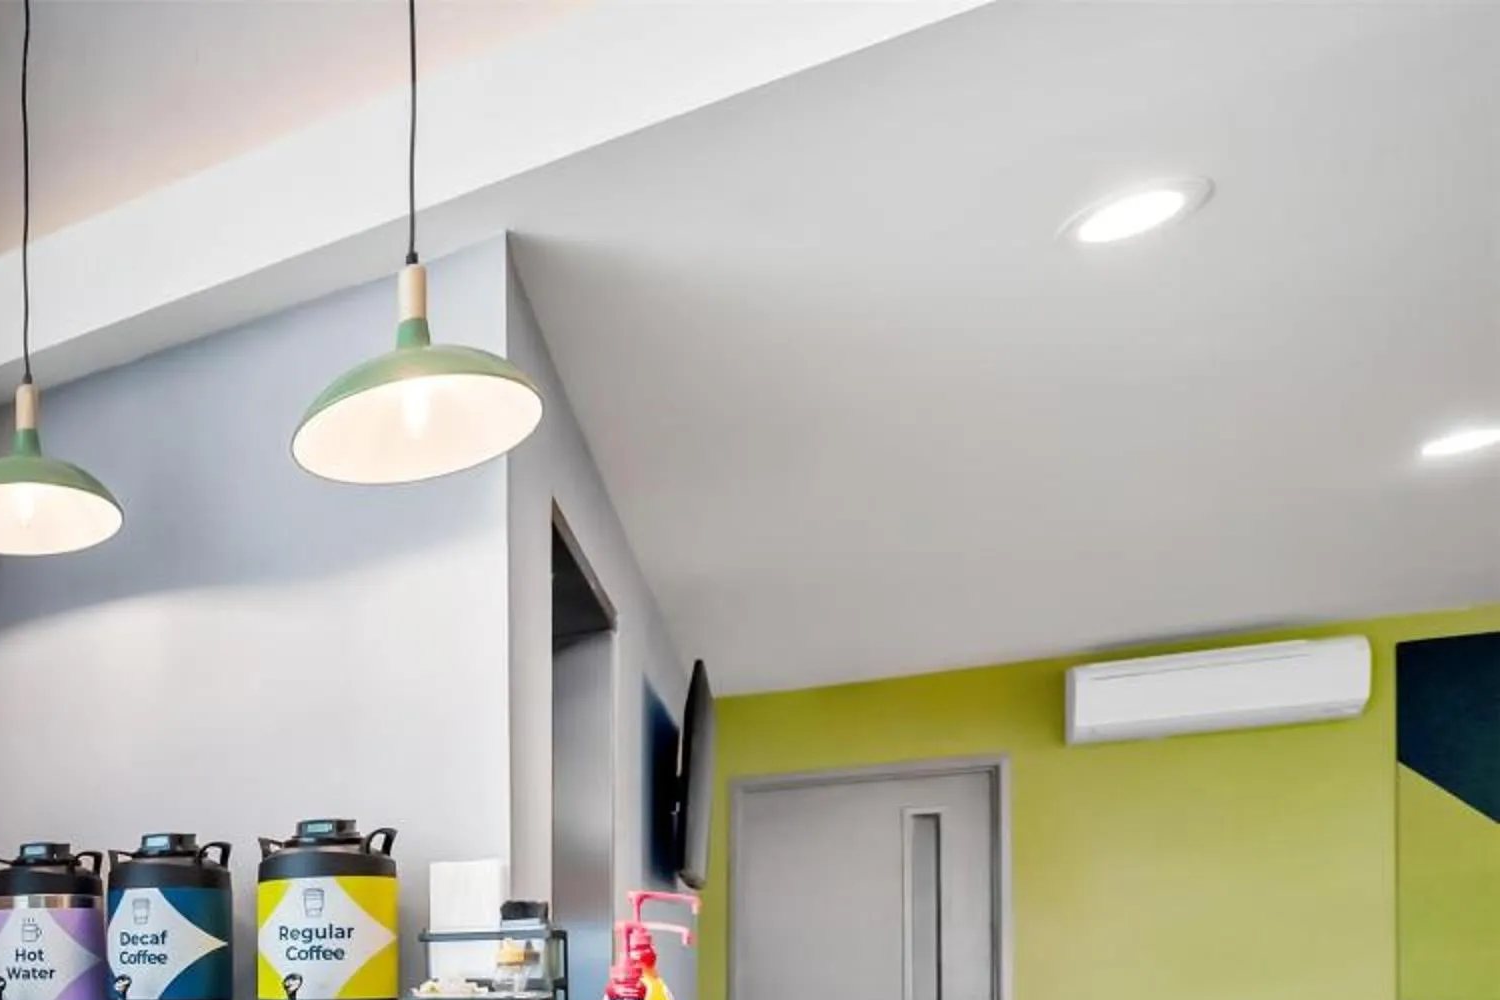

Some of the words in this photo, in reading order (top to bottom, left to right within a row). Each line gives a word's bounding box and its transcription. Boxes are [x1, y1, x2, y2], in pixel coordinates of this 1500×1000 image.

[120, 930, 167, 946] Decaf
[278, 923, 355, 943] Regular
[15, 949, 45, 963] Hot
[120, 950, 168, 965] Coffee
[285, 945, 345, 961] Coffee
[7, 967, 56, 980] Water
